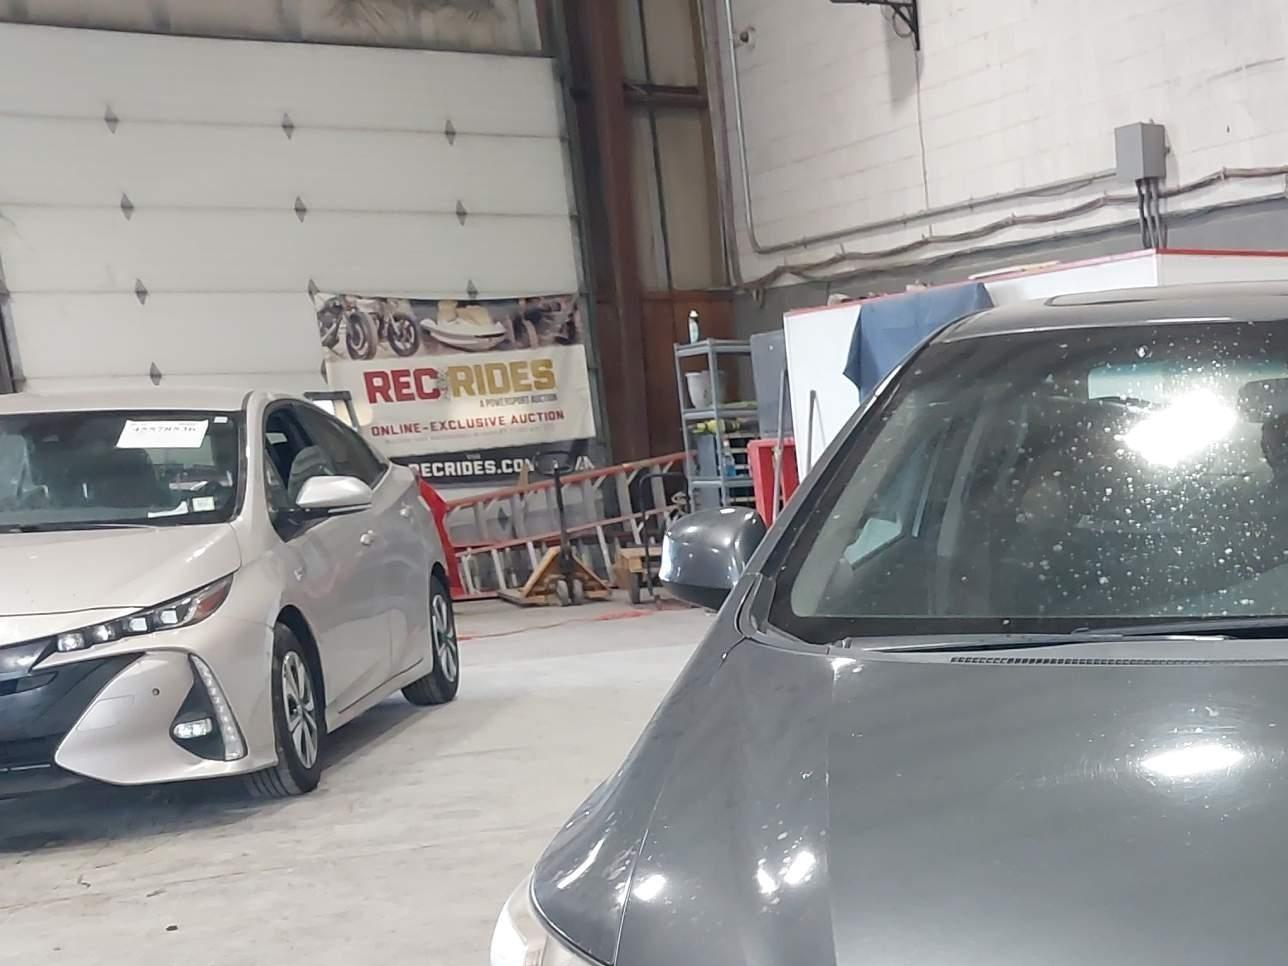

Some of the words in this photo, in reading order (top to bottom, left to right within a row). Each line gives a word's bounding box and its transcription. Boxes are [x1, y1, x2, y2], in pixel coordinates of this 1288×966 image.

[363, 368, 441, 404] REC
[448, 359, 556, 398] RIDES
[371, 416, 505, 436] ONLINE-EXCLUSIVE
[511, 410, 565, 424] AUCTION
